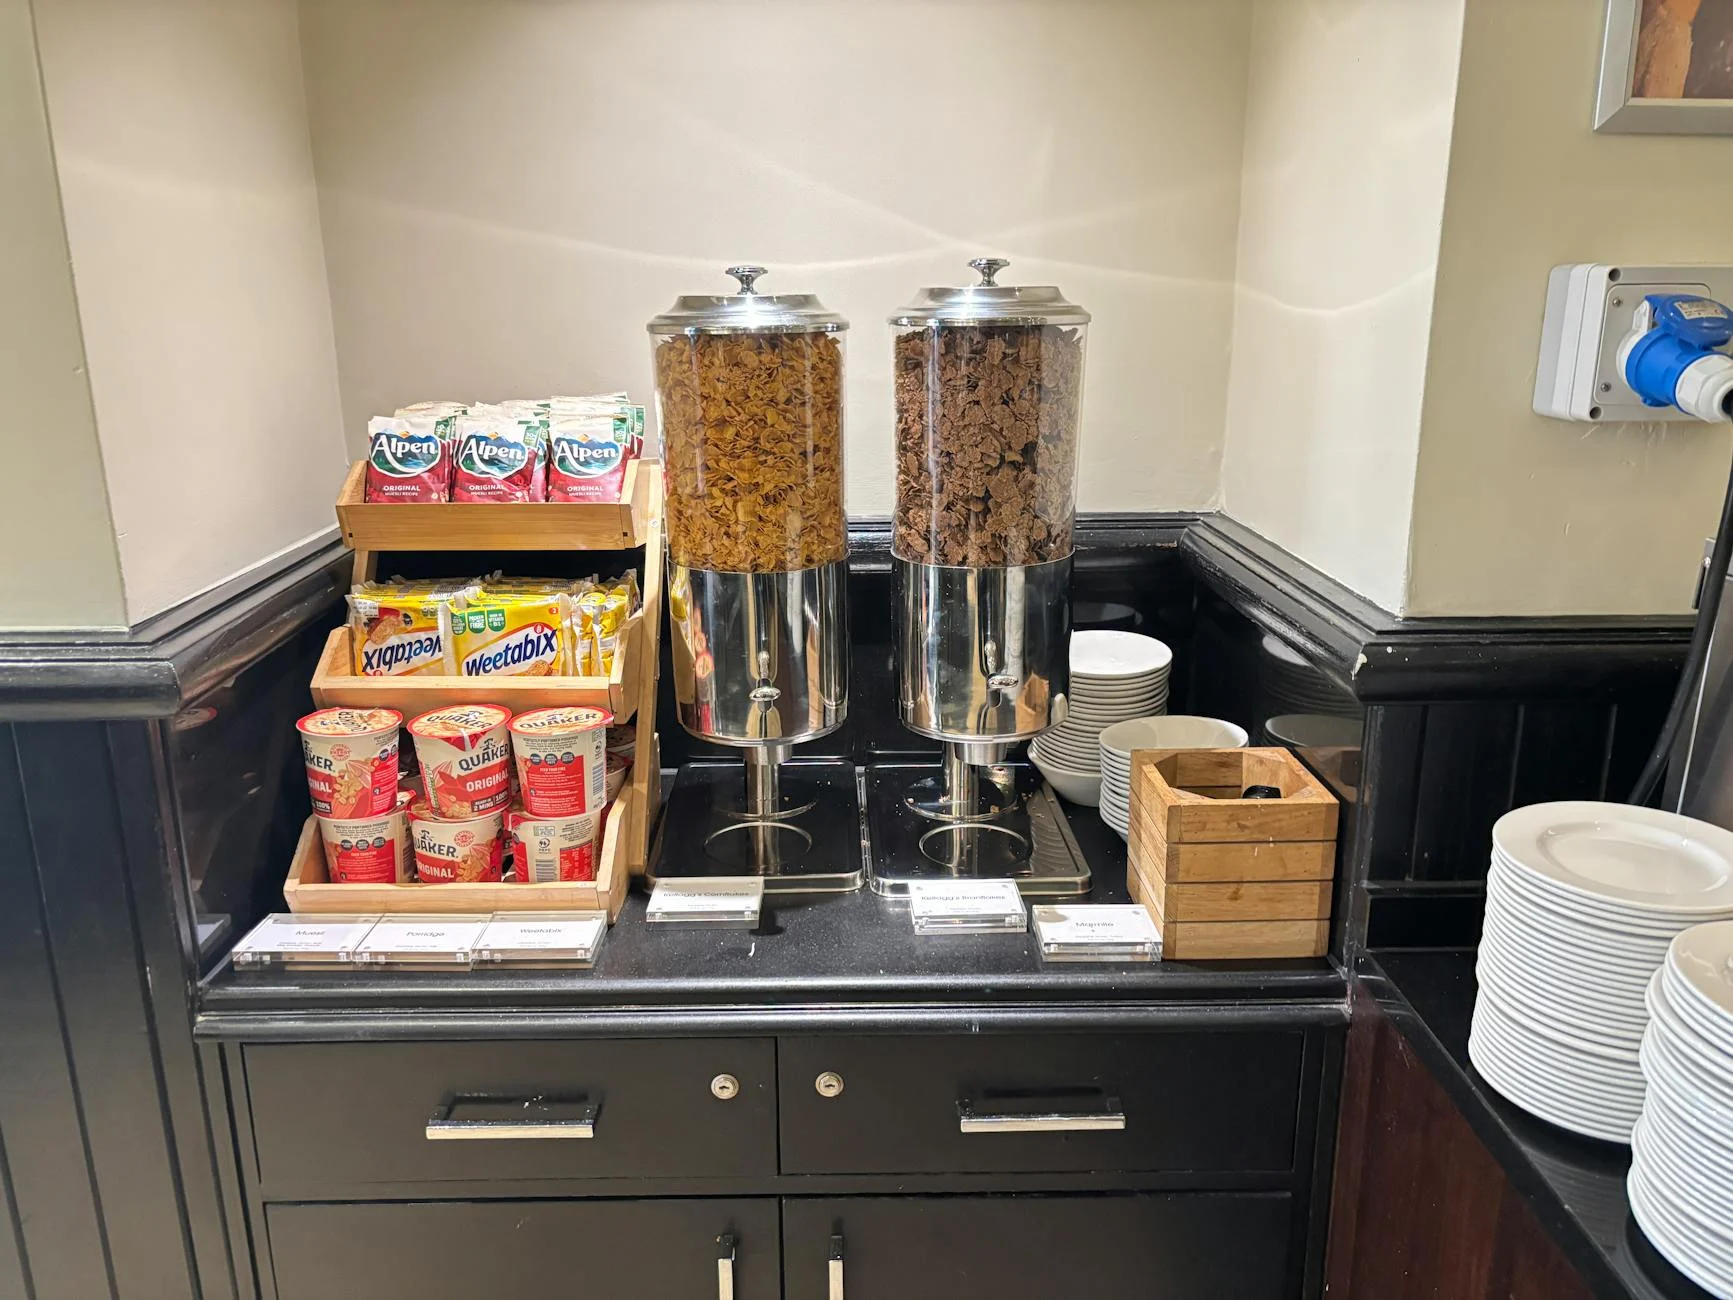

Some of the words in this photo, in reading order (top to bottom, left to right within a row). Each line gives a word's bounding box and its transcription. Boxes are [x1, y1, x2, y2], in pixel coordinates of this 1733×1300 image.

[371, 434, 436, 466] Alpen
[461, 438, 522, 467] Alpen
[556, 441, 617, 468] Alpen
[466, 629, 557, 676] Weetabix
[426, 713, 492, 729] QUAKER
[519, 713, 598, 729] QUAKER
[458, 743, 509, 771] QUAKER
[466, 768, 509, 792] ORIGINAL
[479, 801, 494, 810] MINS
[414, 837, 457, 858] UAKER
[418, 862, 454, 878] RIGINAL
